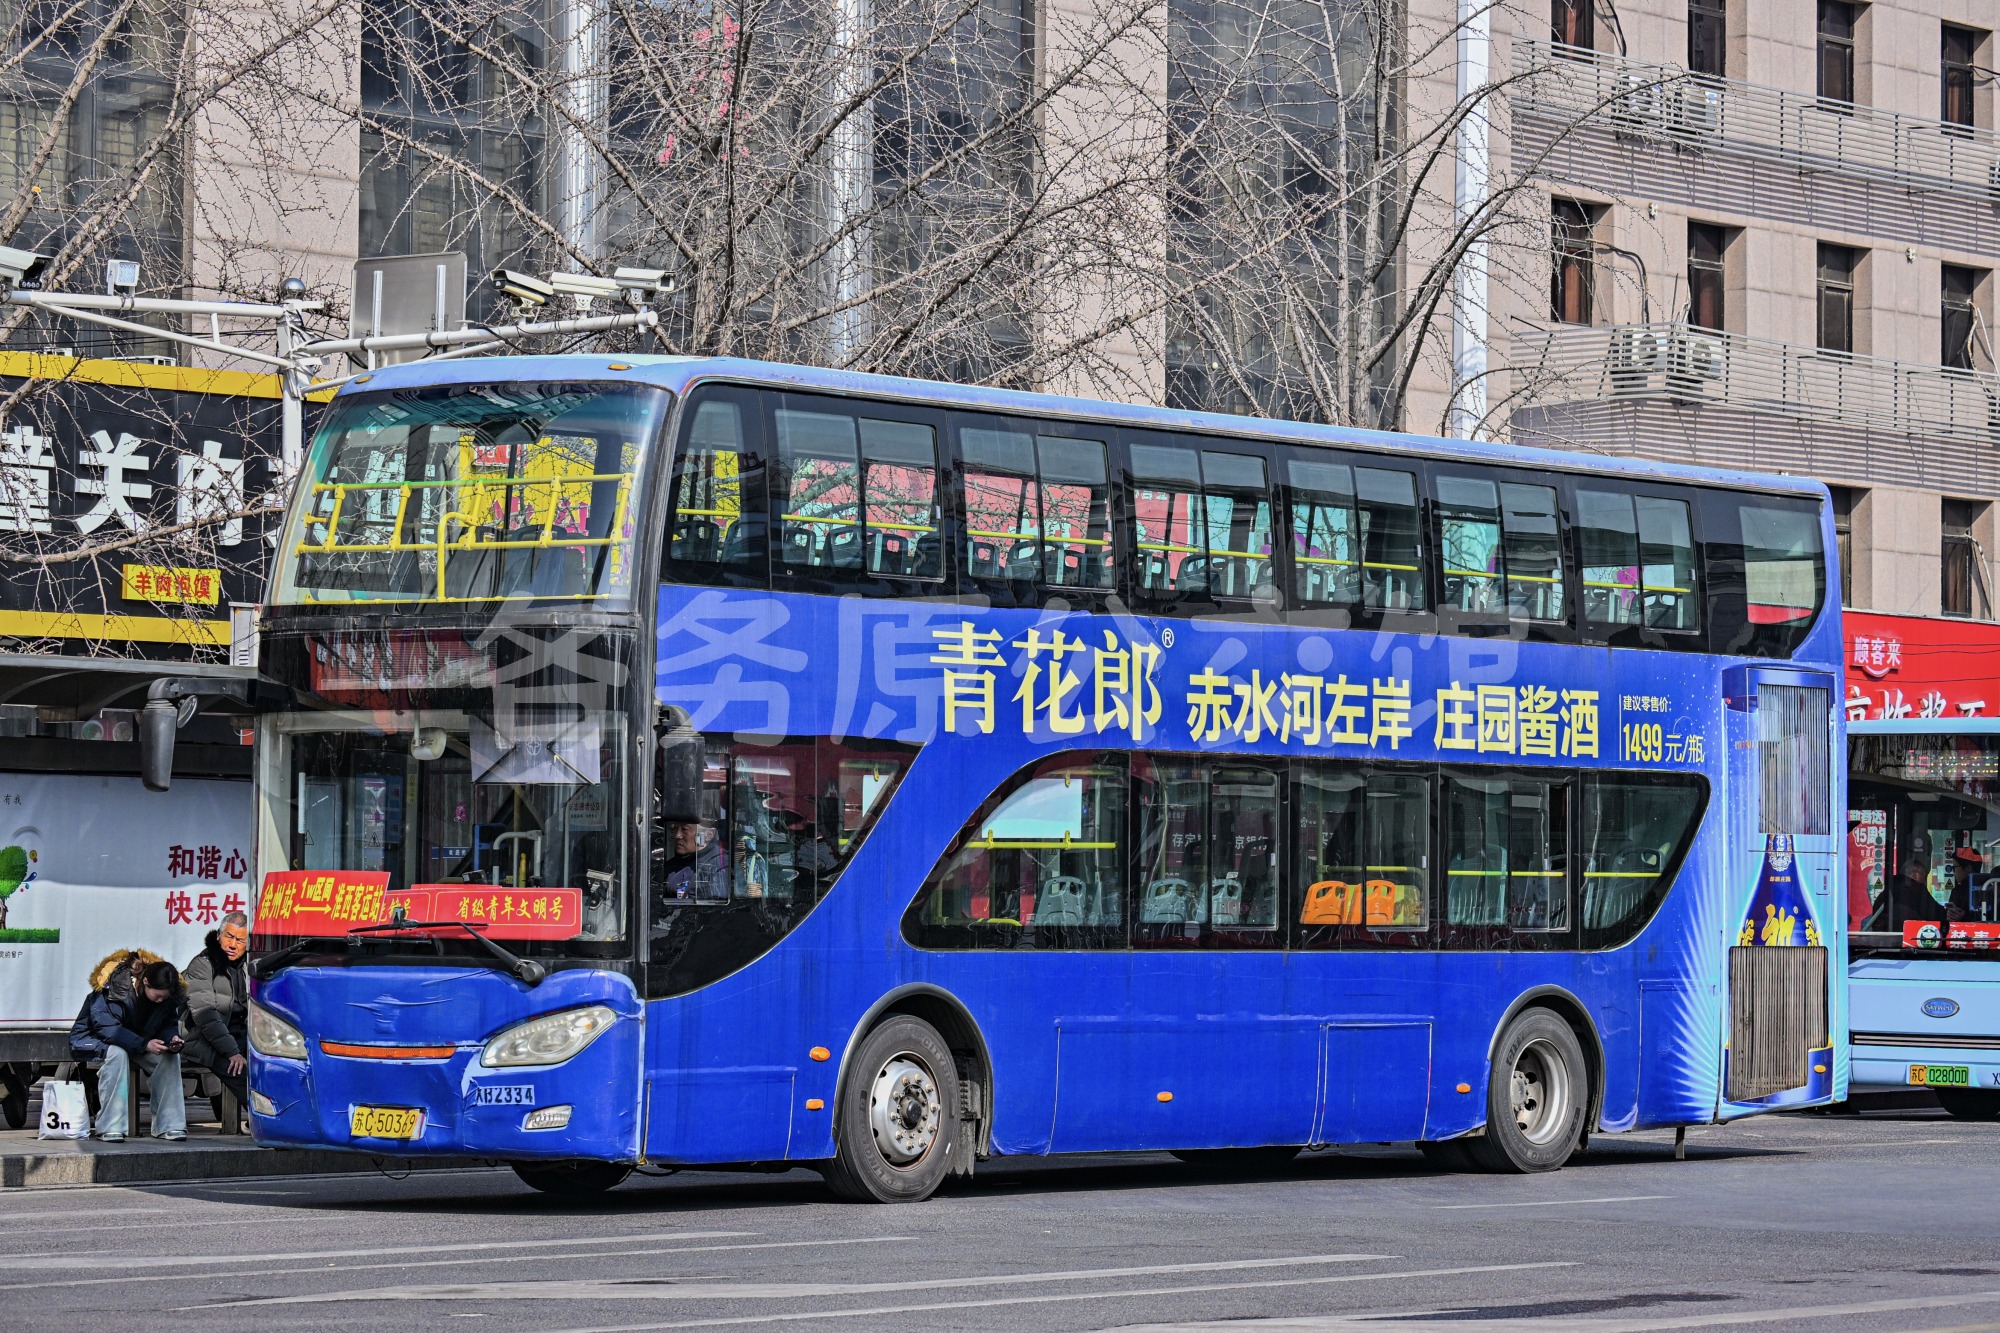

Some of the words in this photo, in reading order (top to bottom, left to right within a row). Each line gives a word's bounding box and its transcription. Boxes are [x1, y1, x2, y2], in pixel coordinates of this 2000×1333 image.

[135, 571, 212, 598] 羊肉泡馍
[1854, 636, 1901, 666] 顺客来
[930, 621, 1163, 740] 青花郎
[1187, 667, 1412, 750] 赤水河左岸
[1433, 681, 1601, 758] 庄园酱酒
[167, 845, 247, 879] 和谐心
[259, 883, 297, 920] 徐州站
[331, 883, 384, 922] 淮西客运站
[456, 895, 564, 922] 省级青年文明号
[1949, 930, 2000, 949] 禁毒
